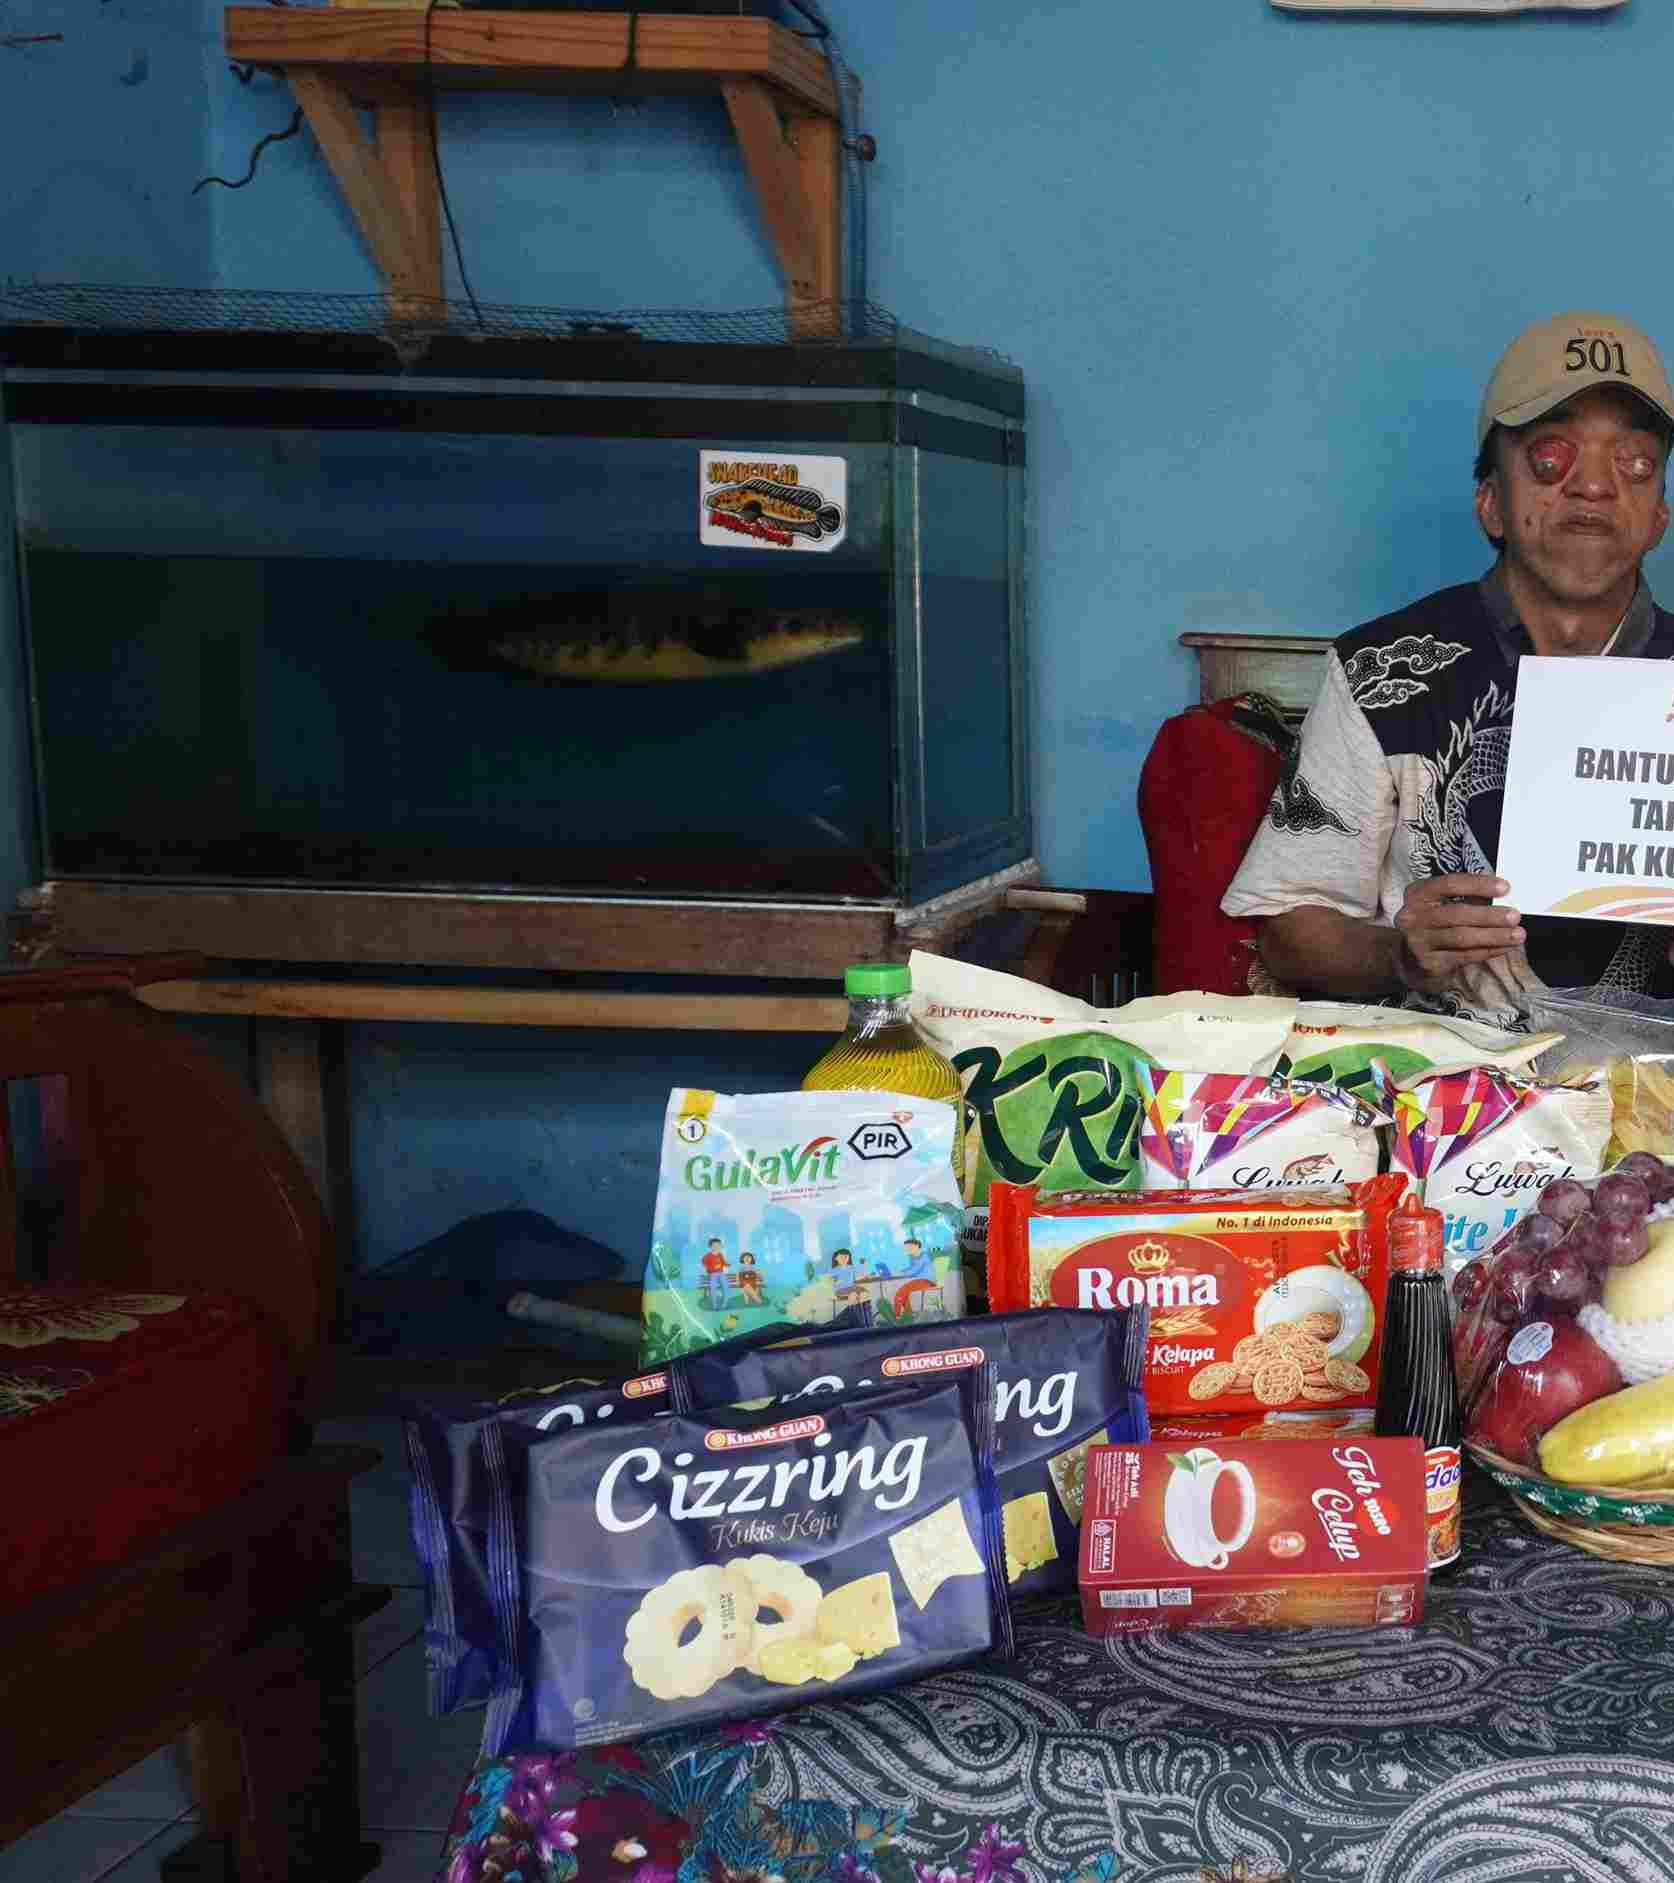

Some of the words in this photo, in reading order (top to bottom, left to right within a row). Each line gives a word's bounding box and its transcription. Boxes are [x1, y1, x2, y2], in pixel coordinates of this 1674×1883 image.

[1565, 338, 1631, 377] 501
[1576, 840, 1638, 876] PAK
[863, 1132, 900, 1151] PIR
[1216, 1217, 1238, 1229] No.
[1242, 1217, 1249, 1228] 1
[1253, 1216, 1265, 1227] di
[1269, 1215, 1333, 1227] Indonesia
[1077, 1267, 1221, 1310] Roma
[900, 1357, 944, 1373] KHONG
[945, 1350, 979, 1366] GUAN
[1152, 1344, 1216, 1367] Kelapa
[727, 1427, 777, 1446] KHONG
[778, 1419, 818, 1438] GUAN
[595, 1434, 929, 1533] Cizzring
[1332, 1446, 1382, 1495] Teh
[1363, 1497, 1392, 1536] SOSRO
[711, 1522, 777, 1550] Kukis
[782, 1509, 840, 1542] Keju
[1311, 1487, 1361, 1562] Celup
[1103, 1537, 1112, 1568] HALAL
